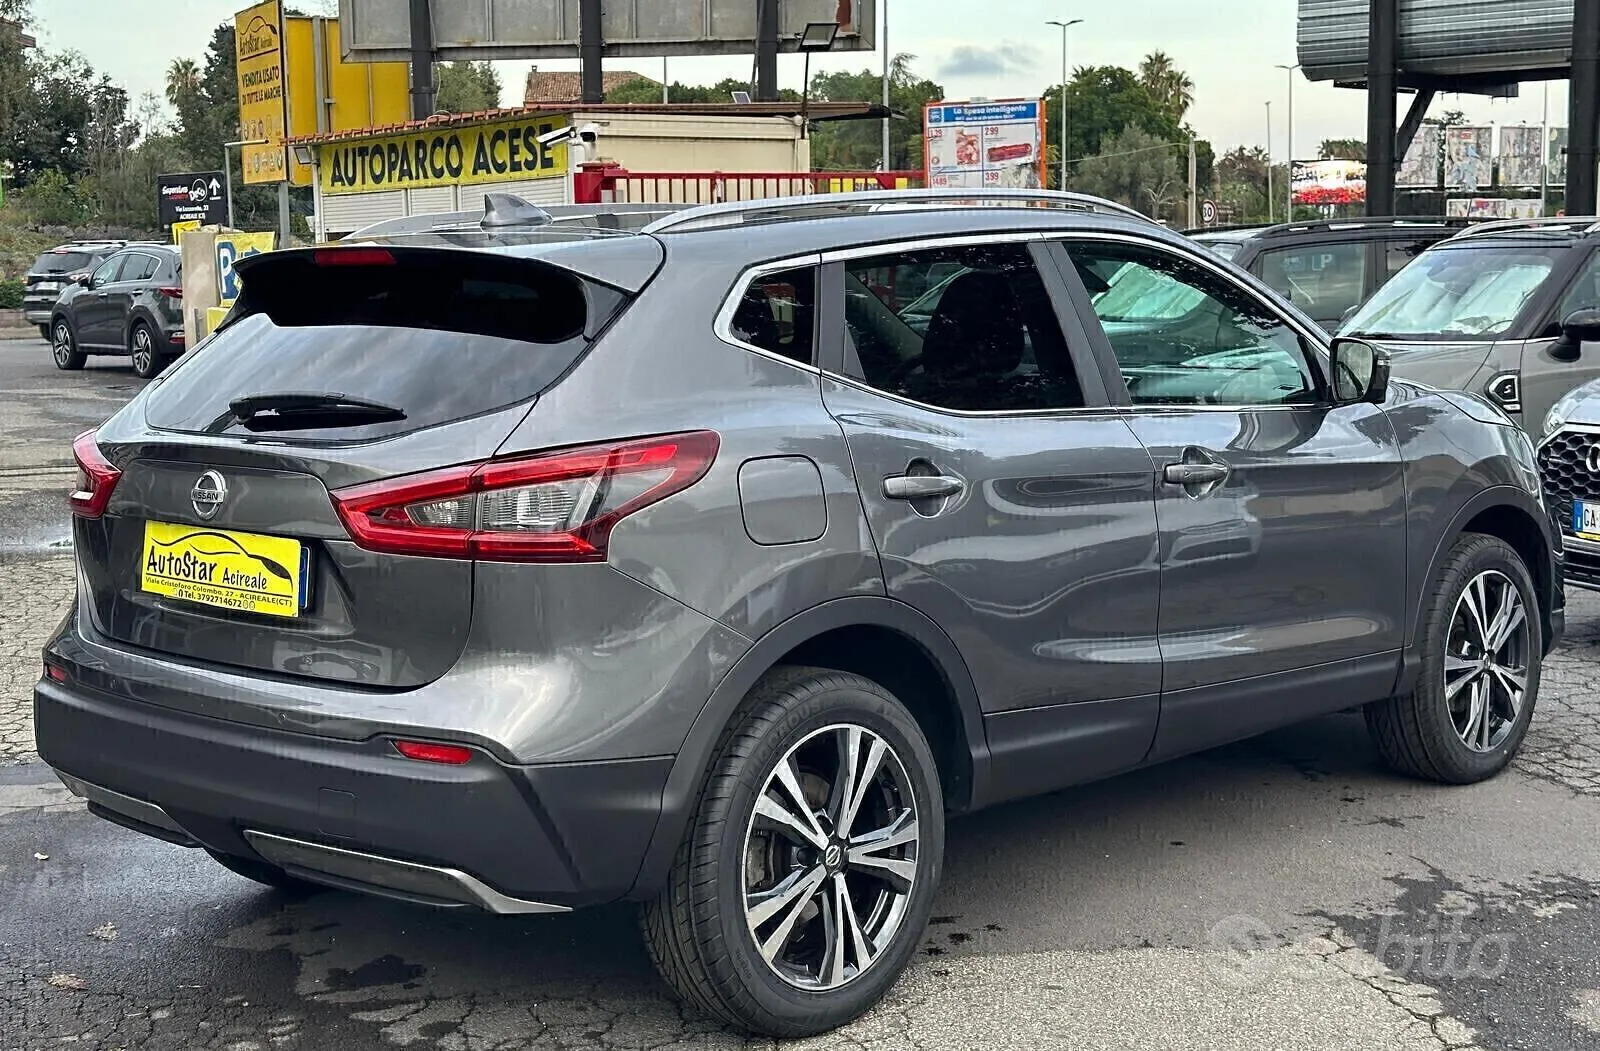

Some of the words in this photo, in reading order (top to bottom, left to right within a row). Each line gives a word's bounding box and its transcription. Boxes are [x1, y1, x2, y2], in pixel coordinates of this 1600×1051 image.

[241, 69, 262, 88] VENDITA
[263, 65, 280, 83] USATO
[246, 91, 259, 104] TUTTE
[263, 85, 281, 100] MARCHE
[963, 107, 985, 116] Spesa
[331, 134, 464, 187] AUTOPARCO
[472, 123, 554, 176] ACESE
[219, 248, 232, 293] P
[191, 490, 218, 501] NISSAN
[147, 545, 217, 581] AutoStar
[145, 577, 160, 585] Viale
[160, 579, 191, 591] Cristoforo
[222, 567, 267, 590] Acireale
[184, 589, 196, 600] Tel.
